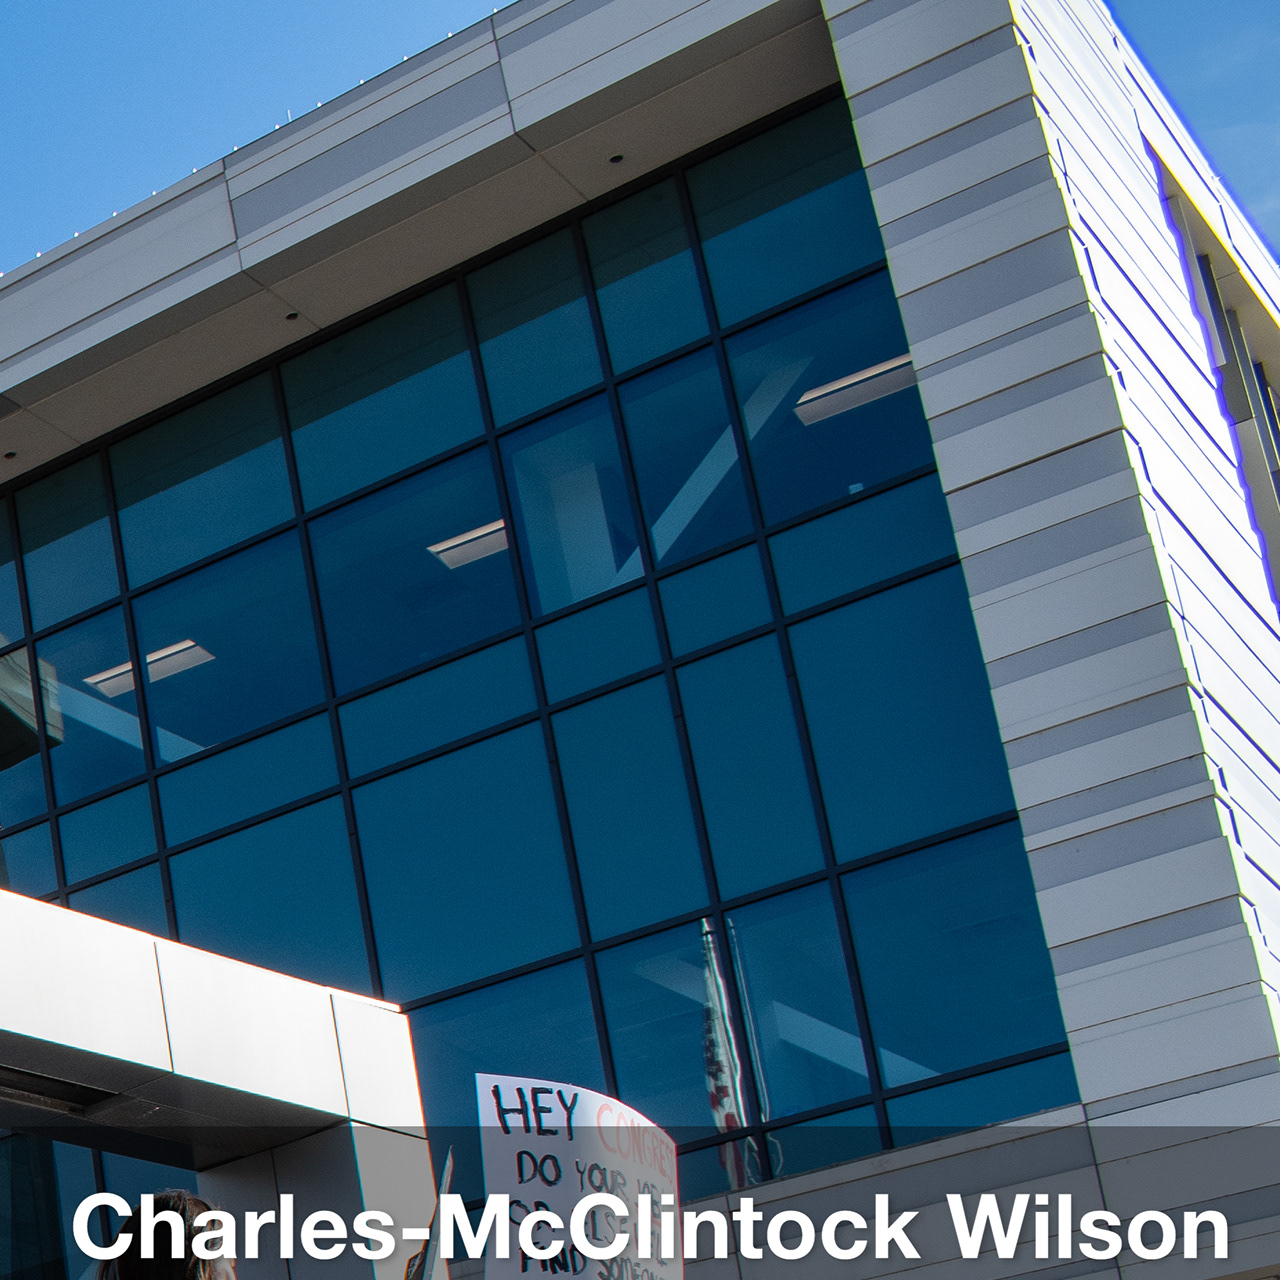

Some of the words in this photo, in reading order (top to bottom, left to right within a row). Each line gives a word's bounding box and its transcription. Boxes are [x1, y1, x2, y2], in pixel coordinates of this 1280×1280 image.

[491, 1084, 578, 1141] HEY
[516, 1150, 562, 1187] DO
[575, 1159, 628, 1201] YOUR
